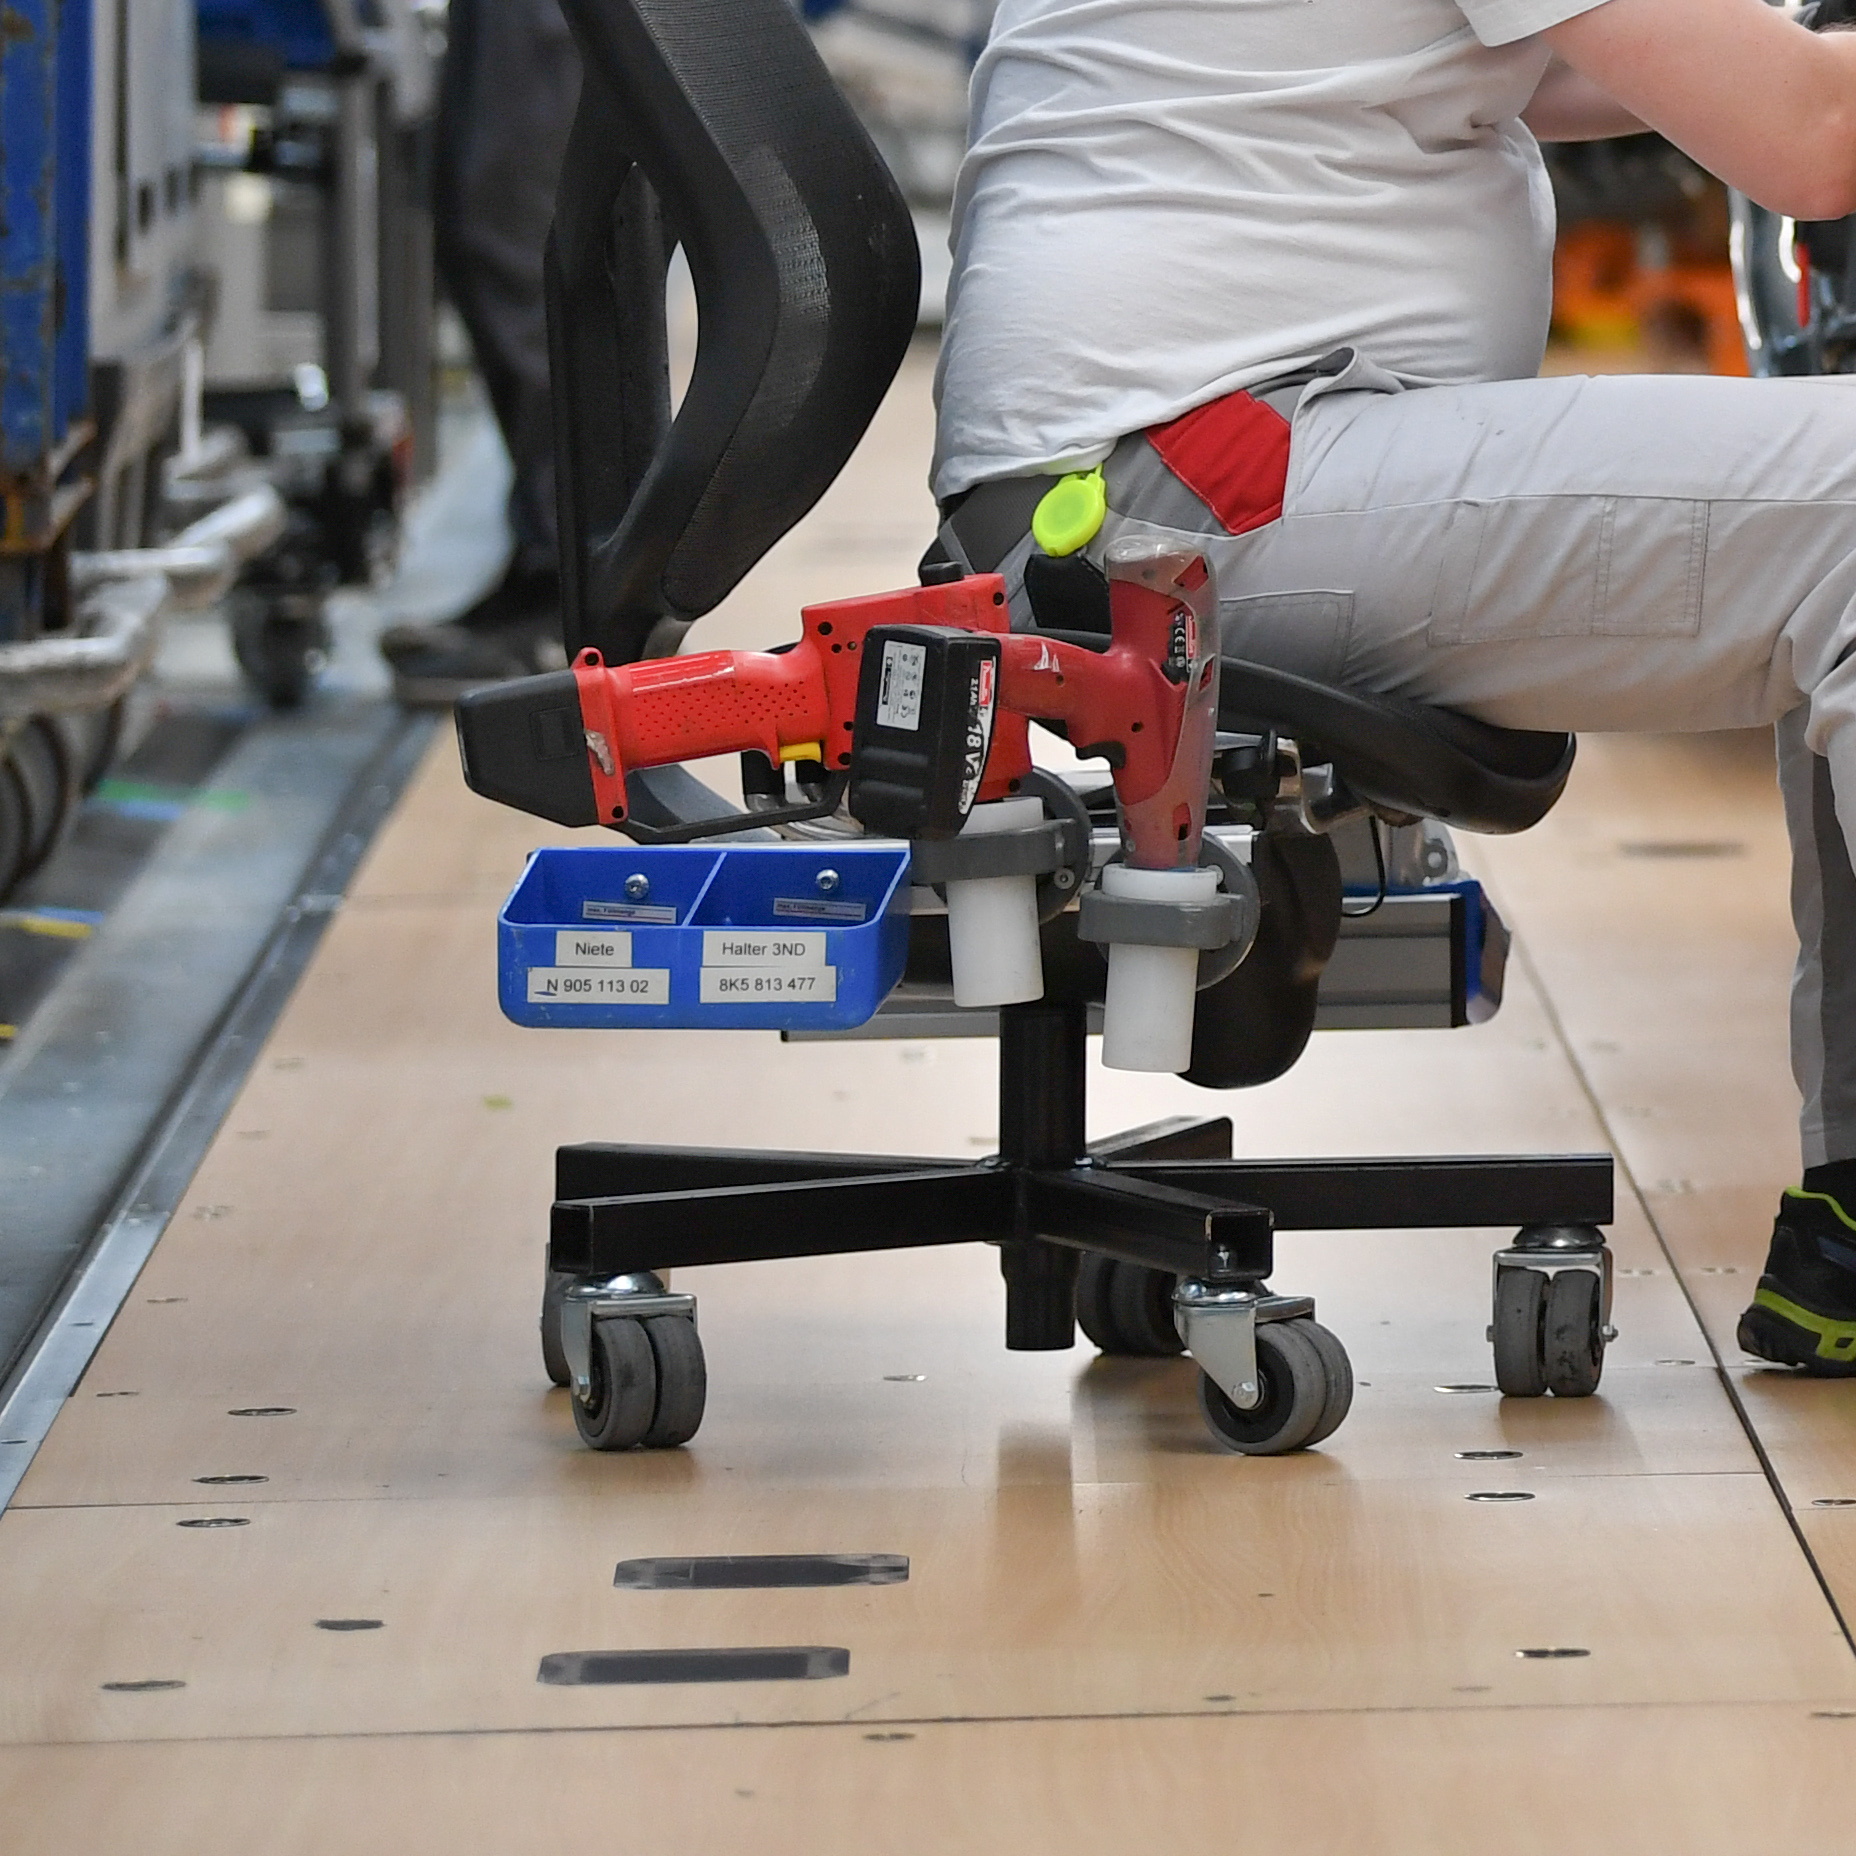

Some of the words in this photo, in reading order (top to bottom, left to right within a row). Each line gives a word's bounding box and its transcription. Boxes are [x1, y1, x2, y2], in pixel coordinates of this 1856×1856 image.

[575, 942, 615, 956] Niete
[722, 942, 768, 956] Halter
[772, 942, 806, 956] 3ND
[546, 978, 559, 992] N
[563, 978, 592, 993] 905
[597, 979, 625, 993] 113
[629, 979, 649, 993] 02
[719, 977, 750, 992] 8K5
[754, 977, 783, 991] 813
[787, 976, 816, 991] 477
